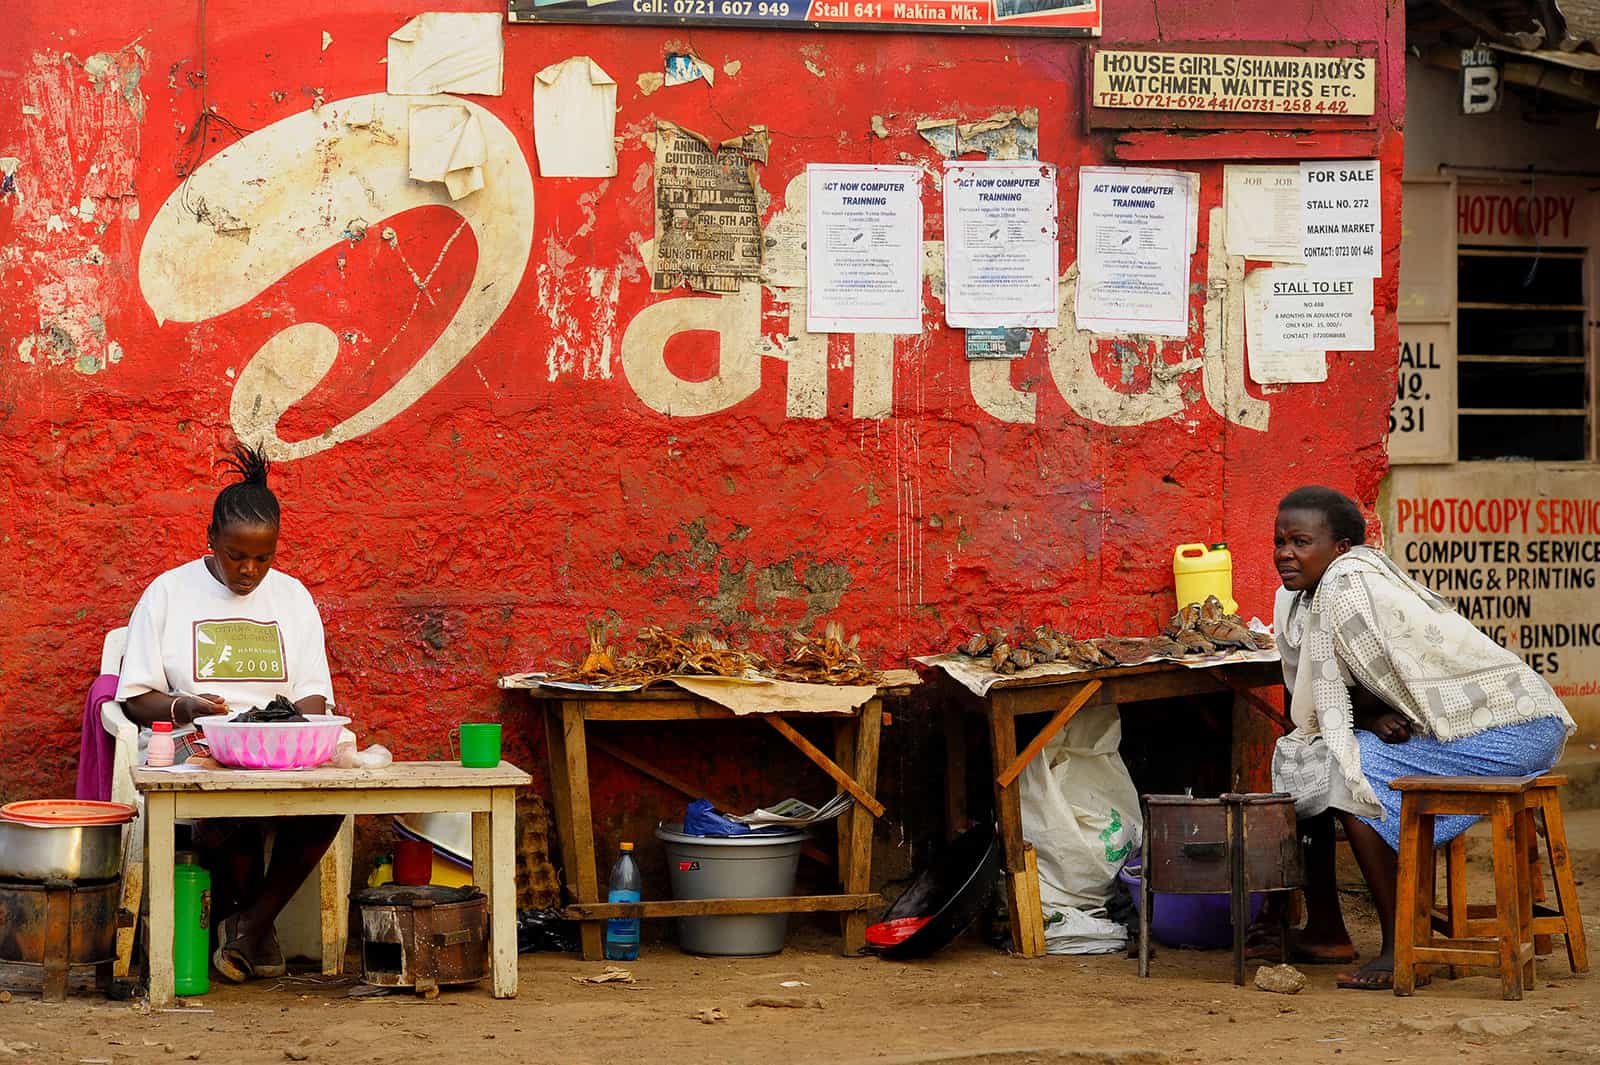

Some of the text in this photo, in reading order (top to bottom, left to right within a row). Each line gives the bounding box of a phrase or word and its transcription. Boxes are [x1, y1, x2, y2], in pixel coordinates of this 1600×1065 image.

[632, 0, 789, 17] Cell: 0721 607 949
[814, 2, 983, 20] Stall 641 Makina Mkt.
[1103, 54, 1175, 74] HOUSE
[1109, 75, 1356, 97] WATCHMEN, WAITERS ETC.
[1463, 67, 1499, 114] B
[959, 179, 1040, 187] ACT NOW COMPUTER
[1274, 178, 1293, 186] JOB
[1308, 170, 1374, 183] FOR SALE
[840, 183, 859, 191] NOW
[861, 183, 905, 192] COMPUTER
[1093, 184, 1174, 195] ACT NOW COMPUTER
[842, 197, 887, 206] TRAINNING
[979, 193, 1022, 201] TRAINNING
[1112, 199, 1156, 208] TRAINNING
[1307, 199, 1369, 210] STALL NO. 272
[719, 214, 737, 226] 6TH
[1457, 195, 1575, 238] HOTOCOPY
[1307, 224, 1375, 234] MAKINA MARKET
[685, 248, 703, 260] 8TH
[706, 249, 735, 261] APRIL
[1304, 248, 1334, 257] CONTACT:
[1335, 247, 1350, 257] 0723
[1350, 247, 1362, 257] 001
[1273, 281, 1354, 294] STALL TO LET
[620, 172, 1270, 433] aitel
[1399, 342, 1440, 369] ALL
[1397, 497, 1531, 534] PHOTOCOPY
[1405, 541, 1521, 563] COMPUTER
[1487, 569, 1501, 590] &
[1506, 568, 1595, 590] PRINTING
[1452, 596, 1531, 620] NATION
[235, 660, 279, 673] 2008
